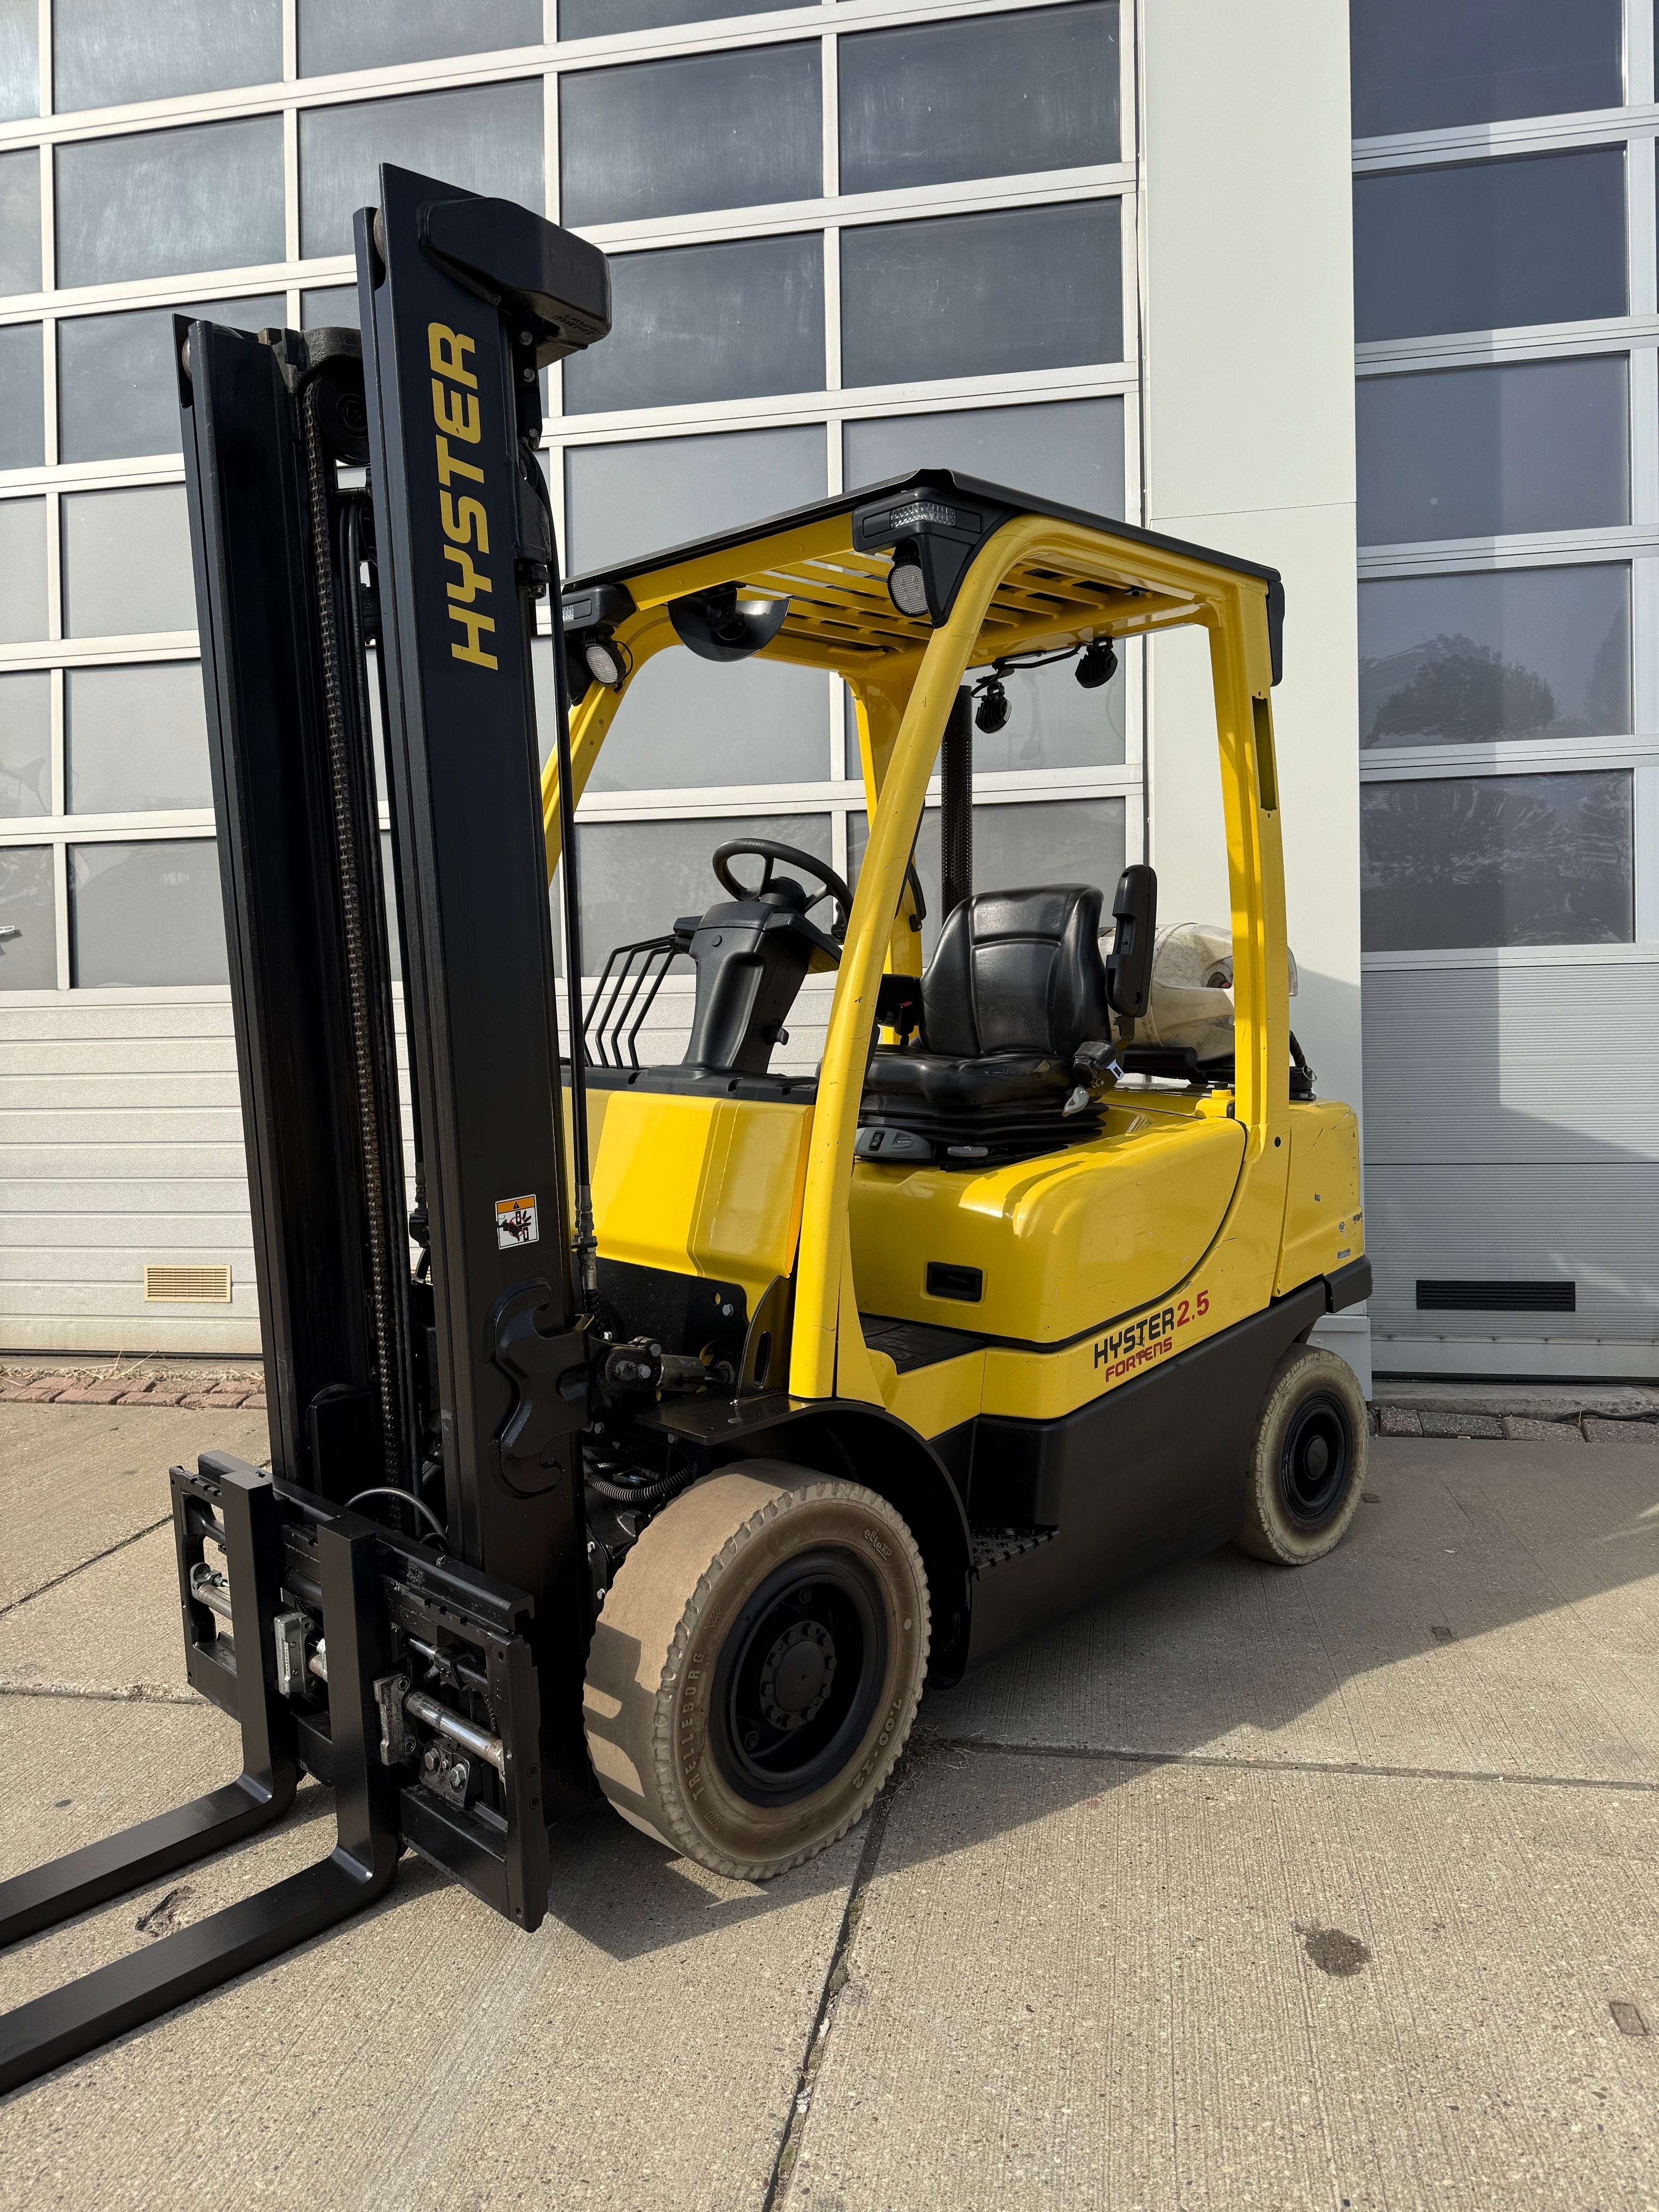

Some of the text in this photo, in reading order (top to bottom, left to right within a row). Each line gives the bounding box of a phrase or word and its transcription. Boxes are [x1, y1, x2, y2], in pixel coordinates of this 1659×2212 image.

[427, 322, 499, 671] HYSTER
[1094, 1289, 1210, 1369] HYSTER 2.5
[1105, 1336, 1173, 1383] FORTENS
[681, 1653, 704, 1801] TRELLEBORG
[852, 1698, 903, 1789] 7.00-12
